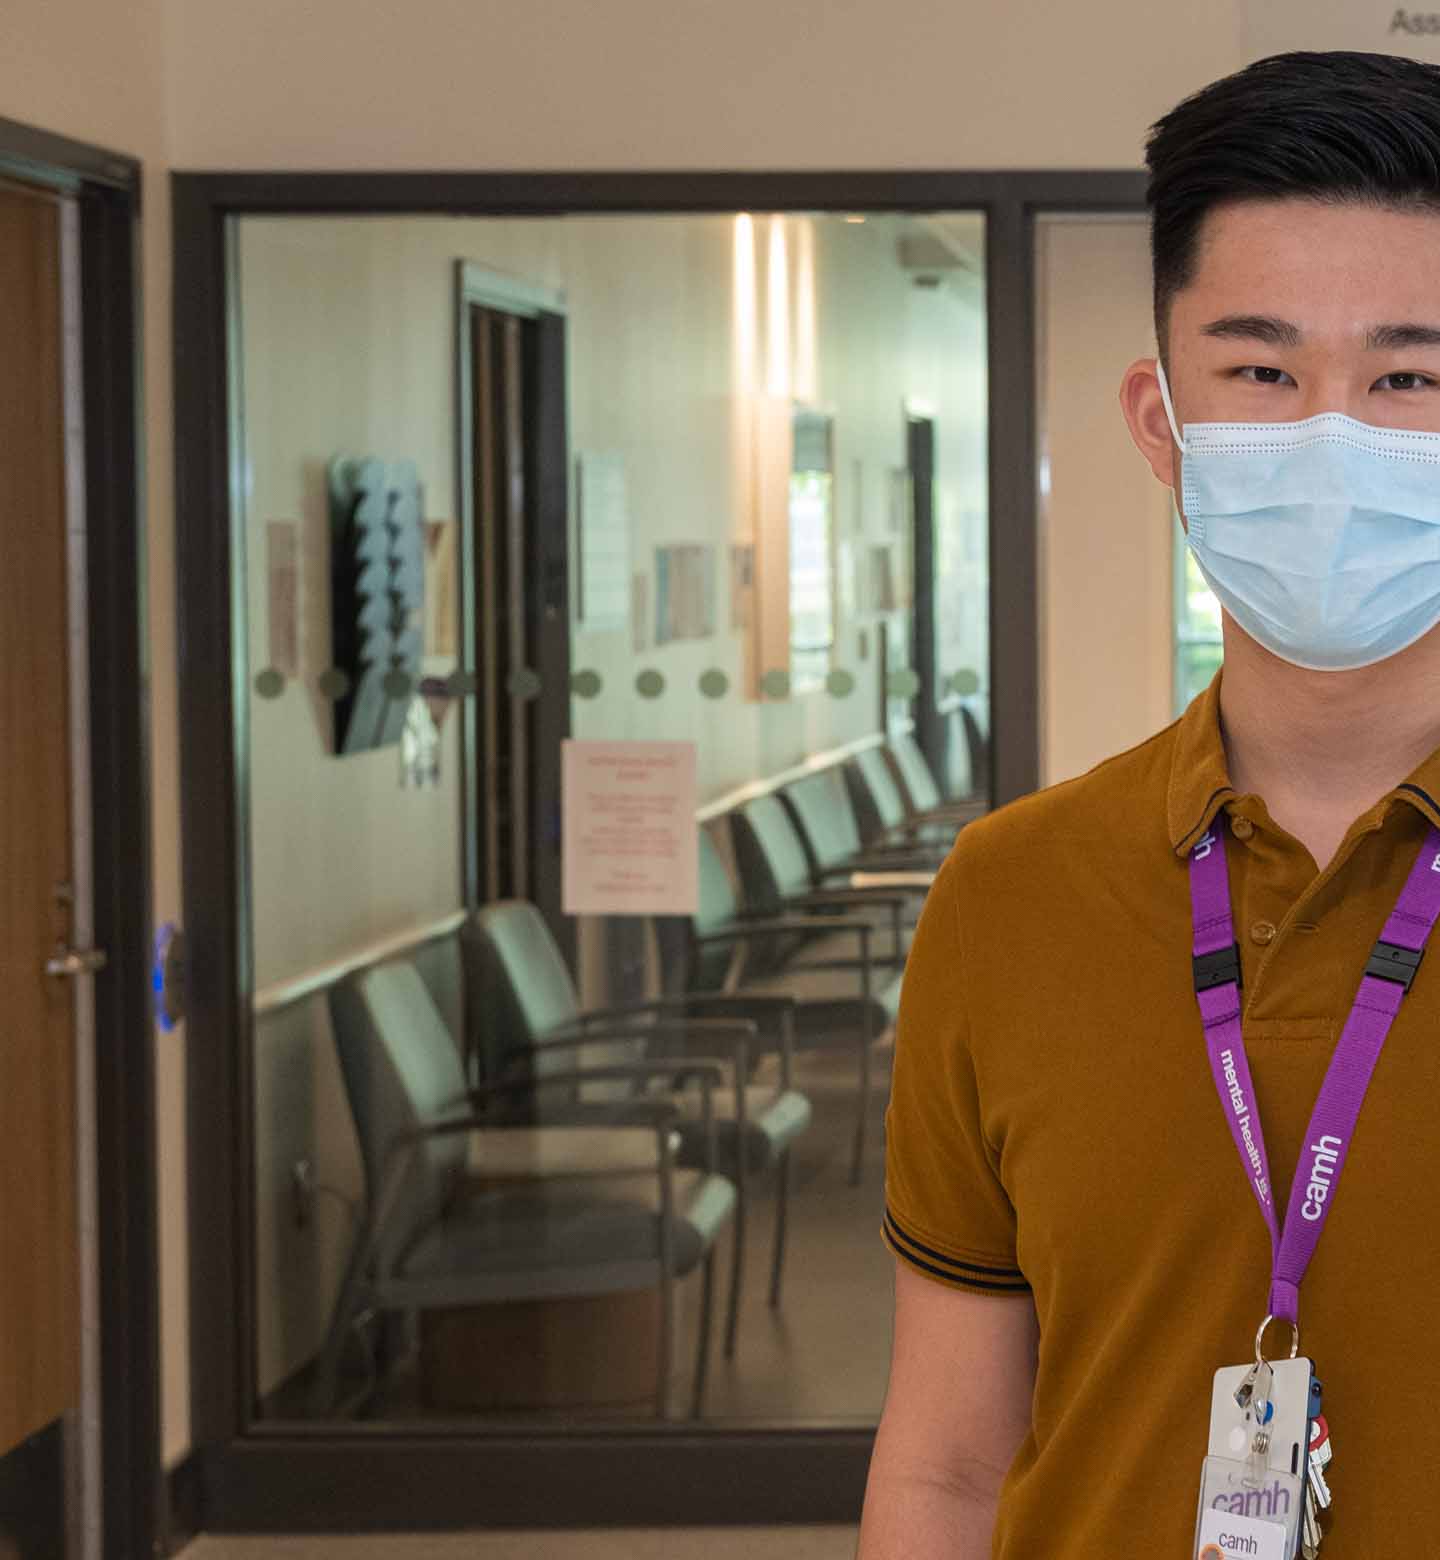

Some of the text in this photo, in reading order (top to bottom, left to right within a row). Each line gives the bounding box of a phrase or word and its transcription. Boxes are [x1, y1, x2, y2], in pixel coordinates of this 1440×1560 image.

[1220, 1049, 1248, 1115] mental
[1238, 1115, 1262, 1176] health
[1301, 1135, 1342, 1221] camh
[1211, 1480, 1290, 1517] camh
[1219, 1532, 1258, 1555] camh
